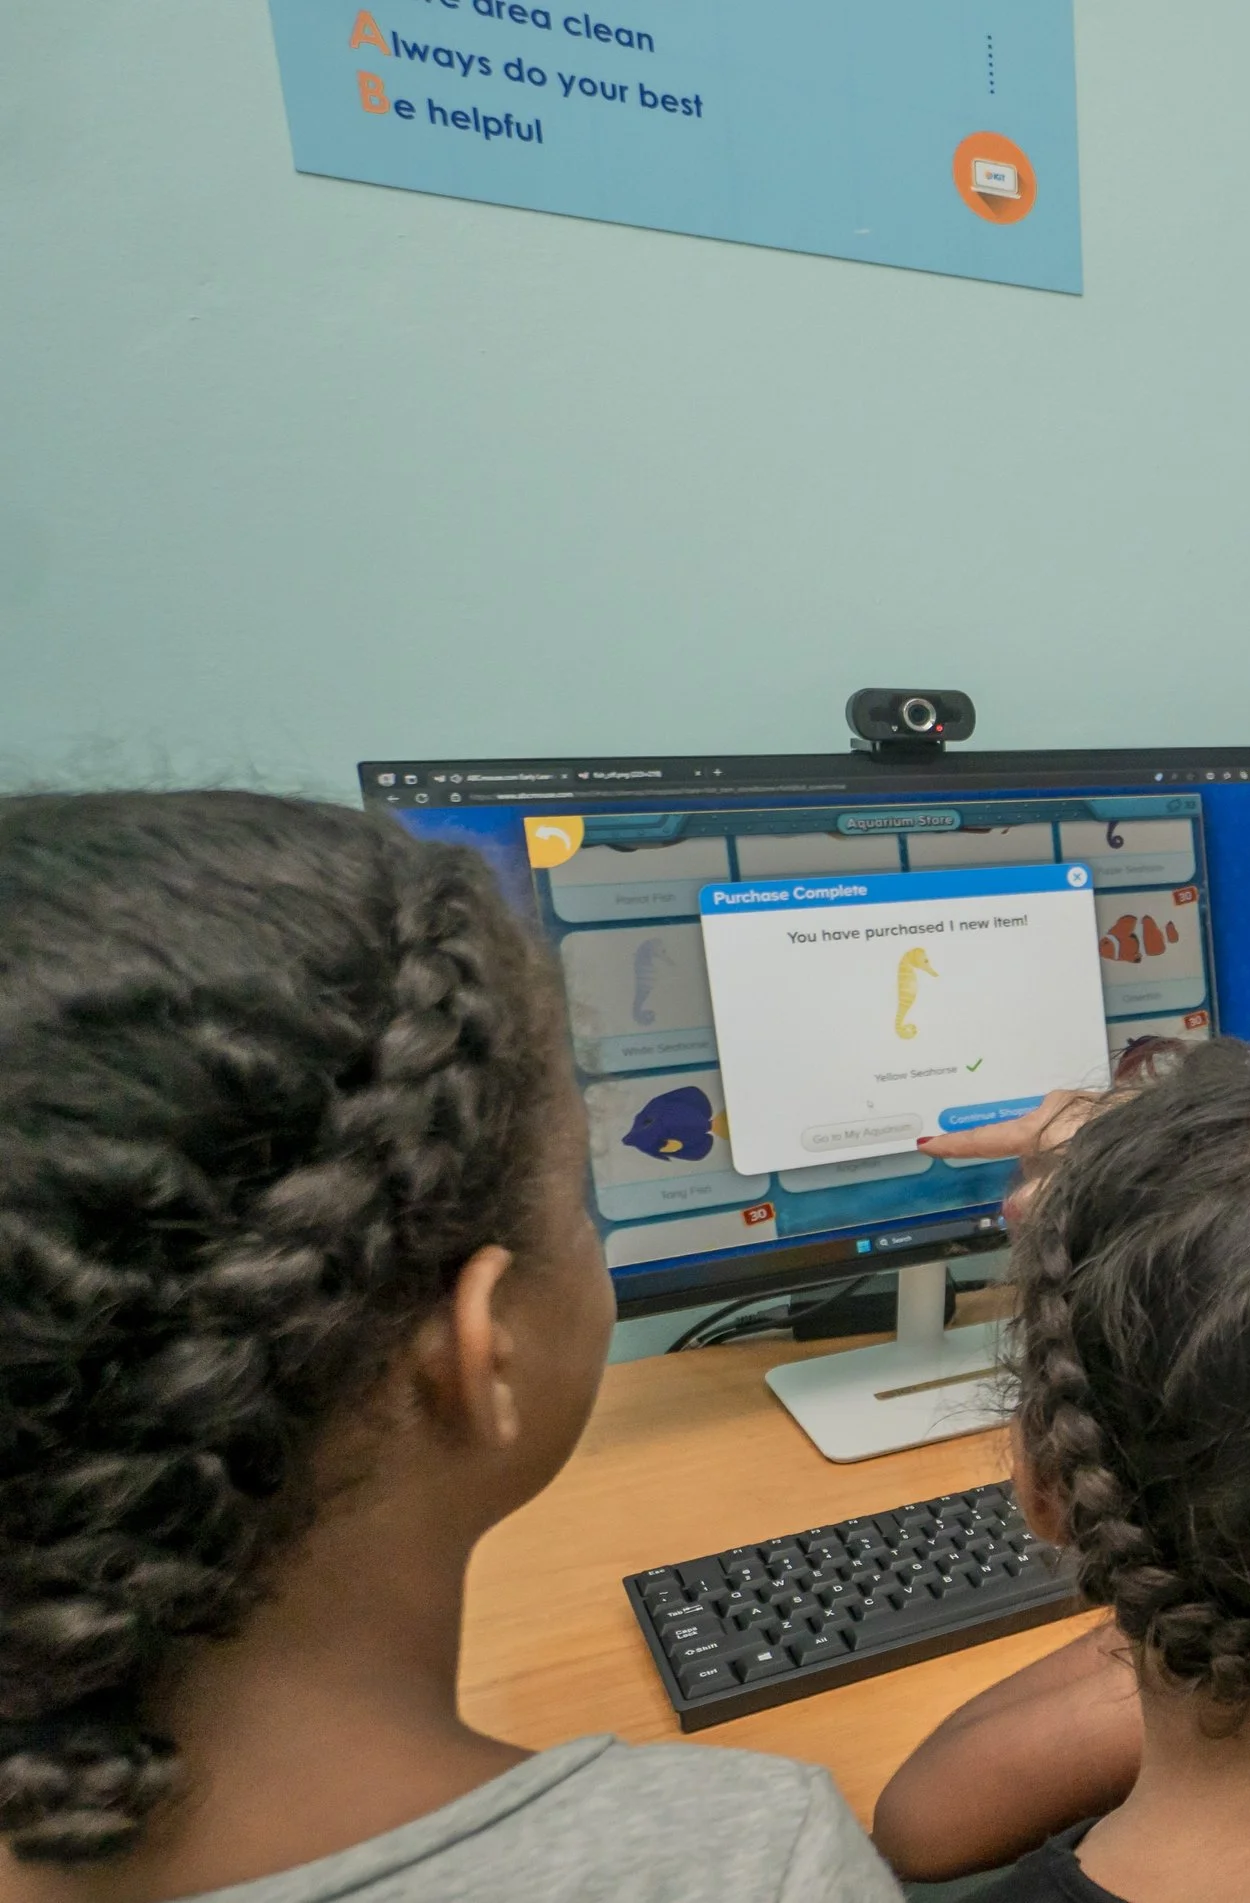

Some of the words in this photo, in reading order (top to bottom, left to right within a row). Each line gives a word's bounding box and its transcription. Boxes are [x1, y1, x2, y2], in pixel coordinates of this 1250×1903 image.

[563, 14, 655, 53] clean
[504, 57, 547, 88] do
[558, 71, 629, 104] your
[639, 83, 704, 118] best
[427, 98, 544, 144] helpful
[847, 817, 913, 832] Aquarium
[919, 815, 953, 827] Store
[713, 889, 789, 905] Purchase
[793, 884, 868, 900] Complete
[787, 931, 817, 944] You
[822, 929, 860, 941] have
[865, 921, 944, 941] purchased
[960, 919, 989, 931] new
[993, 915, 1028, 928] item!
[874, 1072, 907, 1082] Yellow
[909, 1067, 958, 1079] Seahorse
[949, 1111, 997, 1125] Continue
[812, 1133, 830, 1145] Go
[844, 1128, 862, 1140] My
[749, 1208, 767, 1221] 30
[648, 1568, 666, 1576] Esc
[675, 1626, 698, 1636] Caps
[676, 1631, 699, 1640] Lock
[696, 1643, 719, 1653] Shift
[699, 1668, 718, 1678] Ctrl
